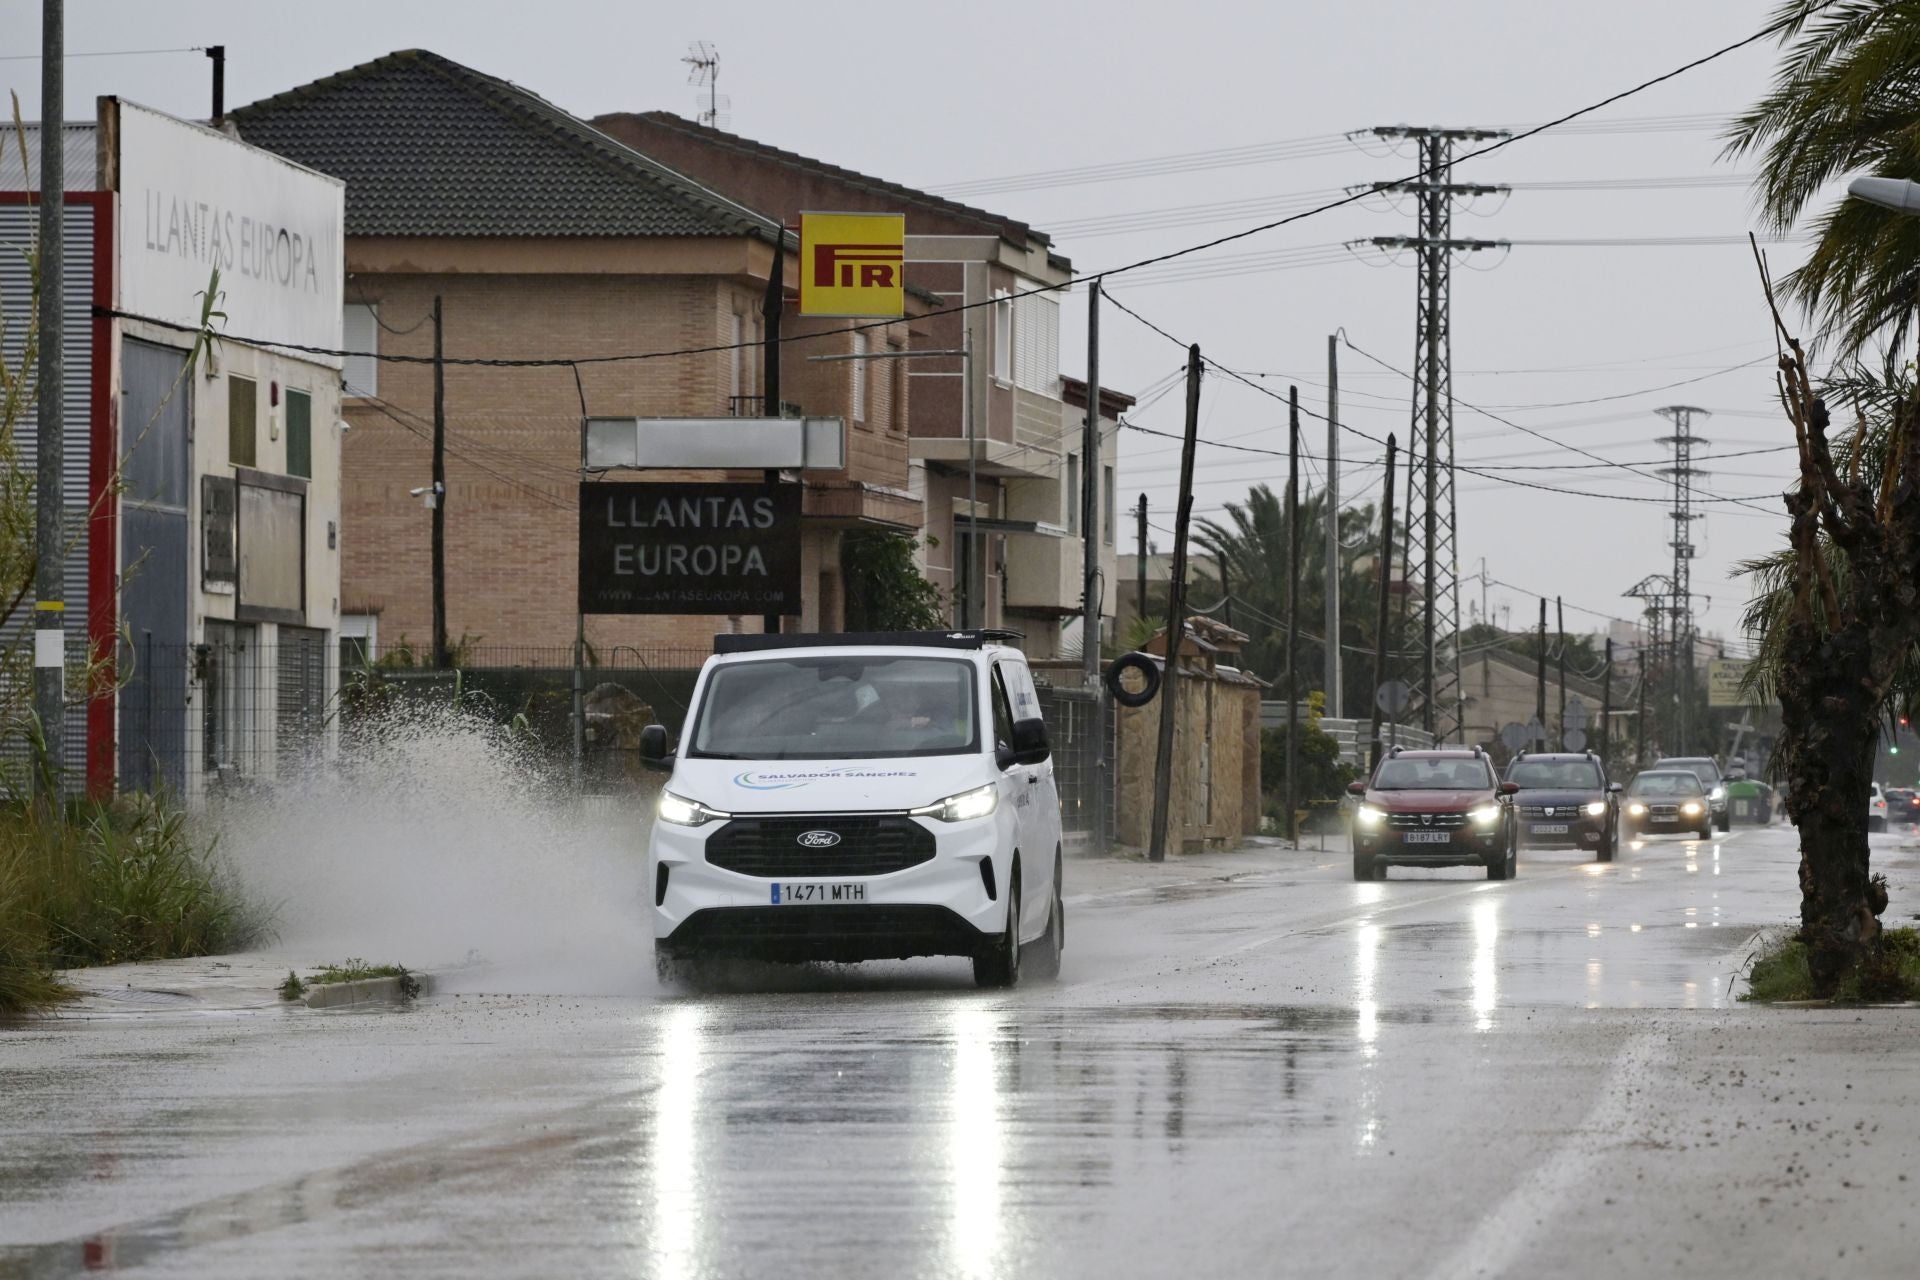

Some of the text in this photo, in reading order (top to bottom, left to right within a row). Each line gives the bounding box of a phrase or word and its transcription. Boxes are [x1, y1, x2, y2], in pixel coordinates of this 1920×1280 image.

[146, 188, 318, 294] LLANTAS EUROPA
[814, 244, 903, 287] PIR
[607, 496, 775, 529] LLANTAS
[614, 543, 767, 576] EUROPA
[758, 772, 841, 780] SALVADOR
[804, 832, 834, 845] Ford
[786, 884, 864, 901] 1471 MTH
